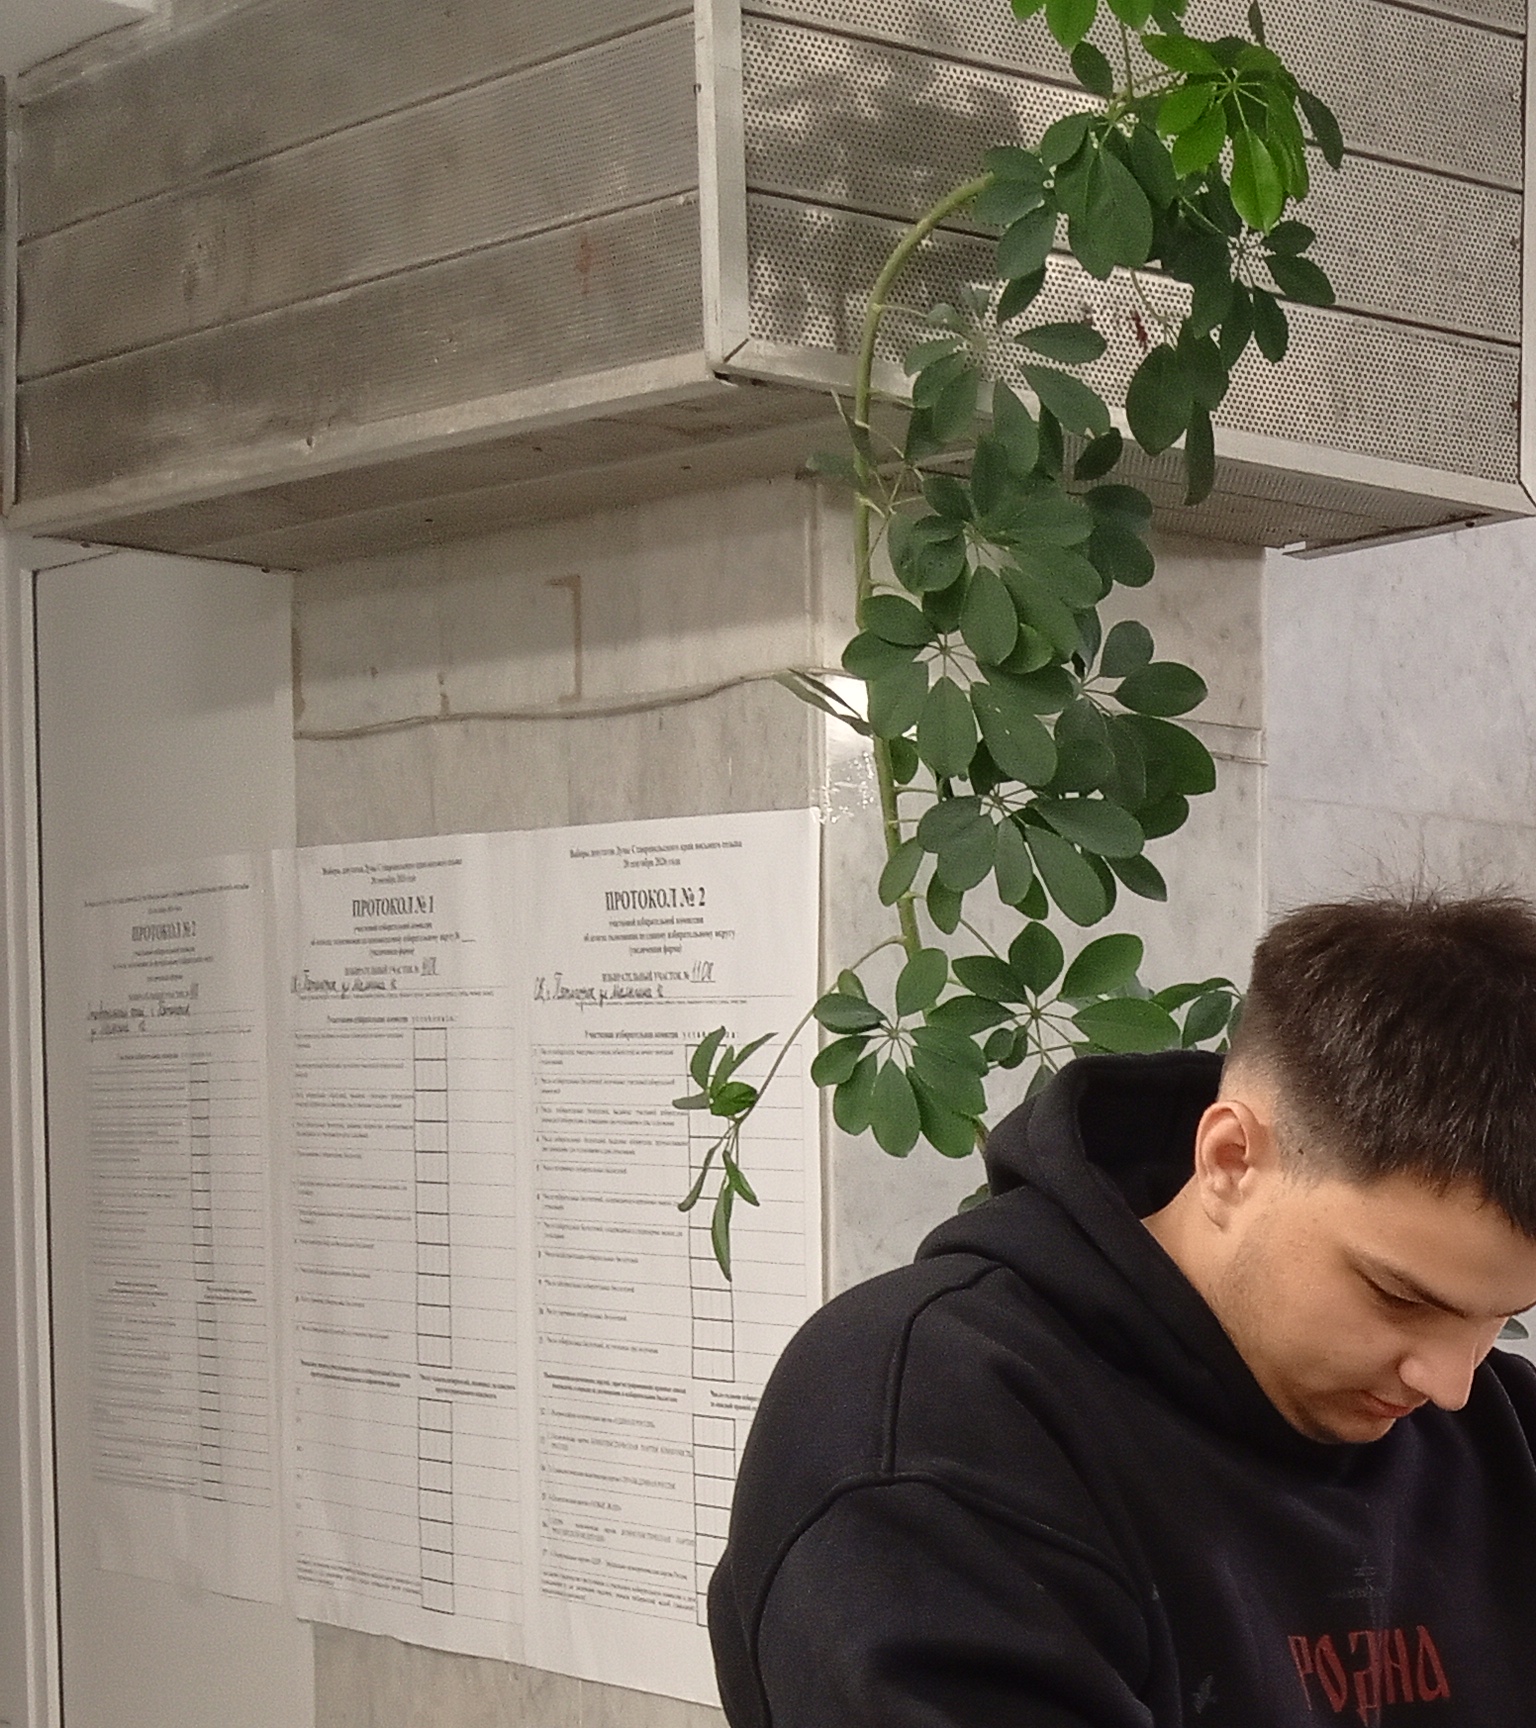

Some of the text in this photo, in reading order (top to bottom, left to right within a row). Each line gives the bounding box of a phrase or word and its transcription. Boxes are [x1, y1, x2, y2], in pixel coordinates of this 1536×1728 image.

[352, 896, 413, 917] ПРОТОКОЛ
[605, 888, 677, 911] ПРОТОКОЛ
[699, 887, 706, 907] 2
